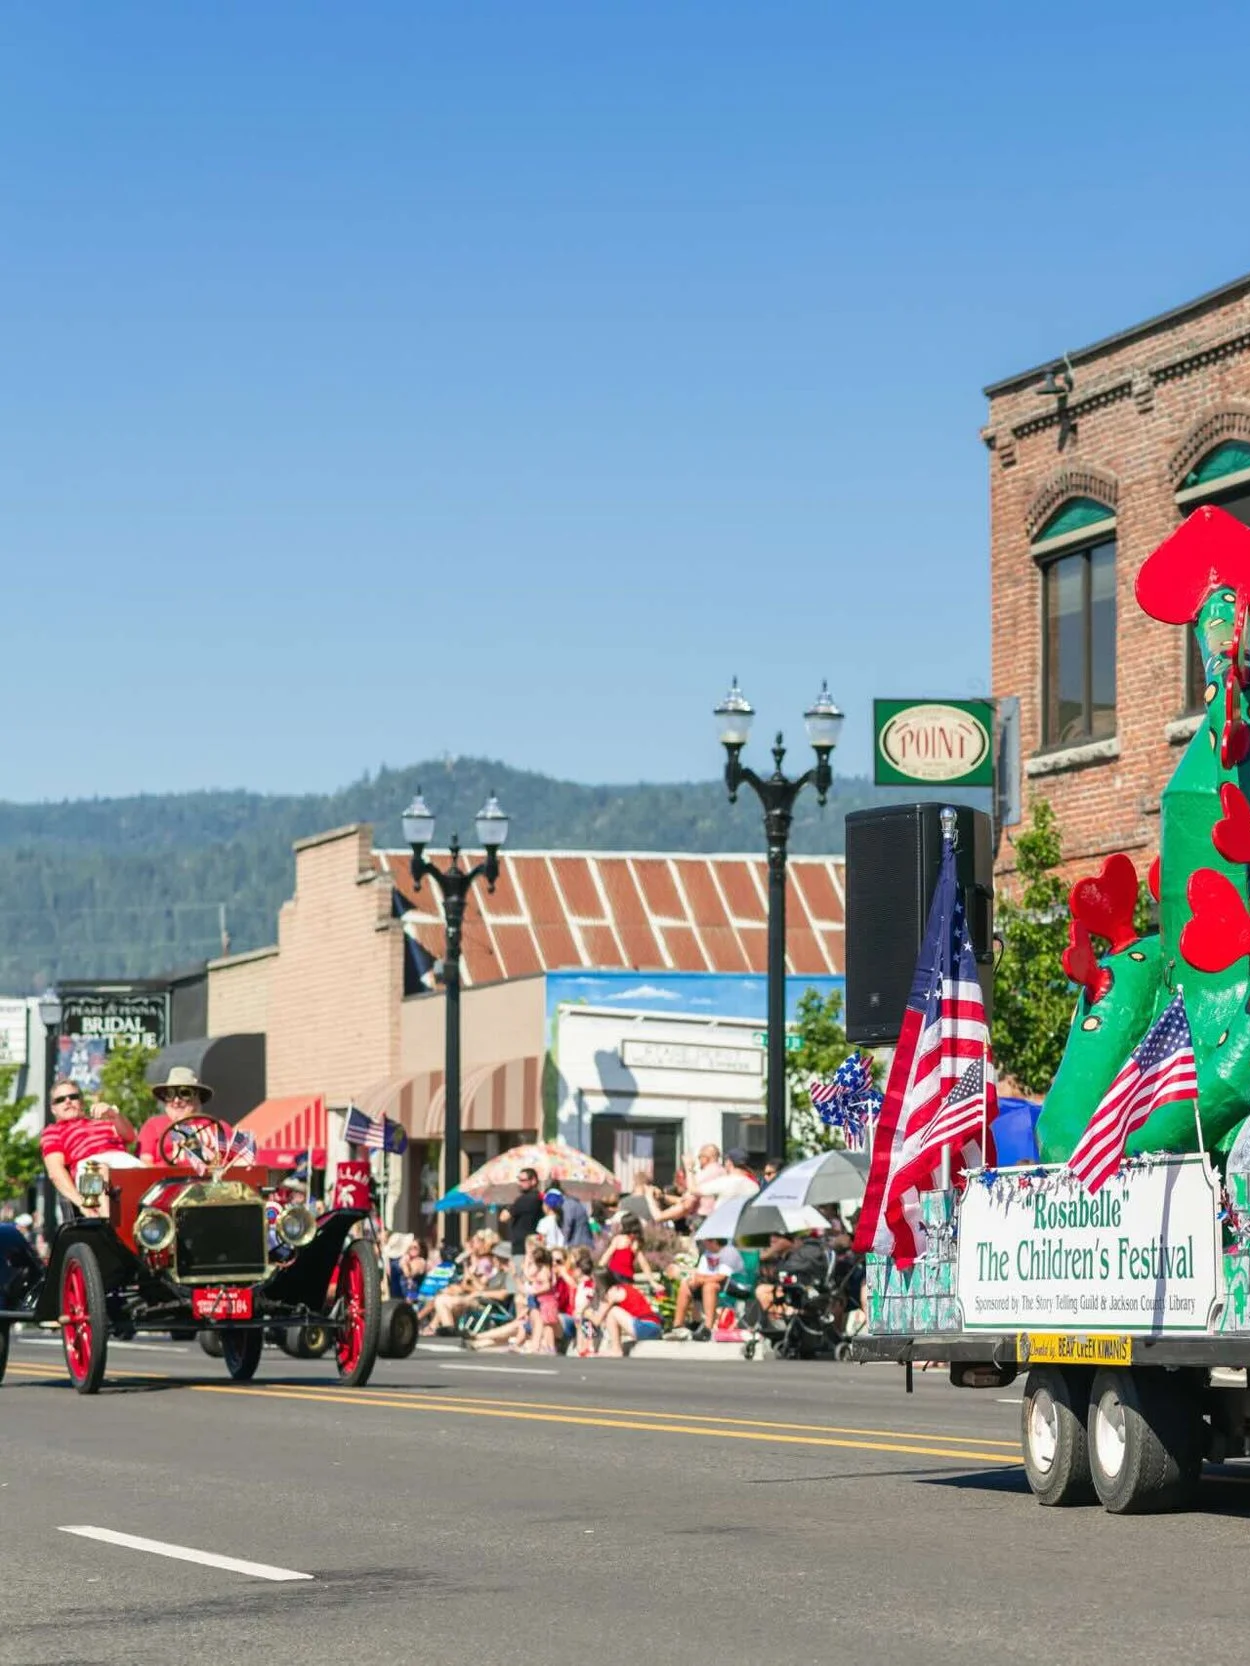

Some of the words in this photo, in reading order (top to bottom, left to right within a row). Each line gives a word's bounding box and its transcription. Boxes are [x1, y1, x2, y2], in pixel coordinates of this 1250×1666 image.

[894, 722, 973, 759] POINT
[82, 1016, 147, 1034] BRIDAL
[1025, 1189, 1130, 1231] "Rosabelle"
[976, 1240, 1010, 1282] The
[1017, 1237, 1110, 1281] Children's
[1117, 1235, 1195, 1280] Festival
[975, 1294, 1010, 1314] Sponsored
[1011, 1295, 1019, 1315] by
[1021, 1294, 1034, 1311] The
[1035, 1294, 1053, 1314] Story
[1055, 1294, 1079, 1315] Telling
[1080, 1294, 1099, 1311] Guild
[1100, 1296, 1107, 1311] &
[1109, 1295, 1139, 1311] Jackson
[1168, 1294, 1196, 1315] Library
